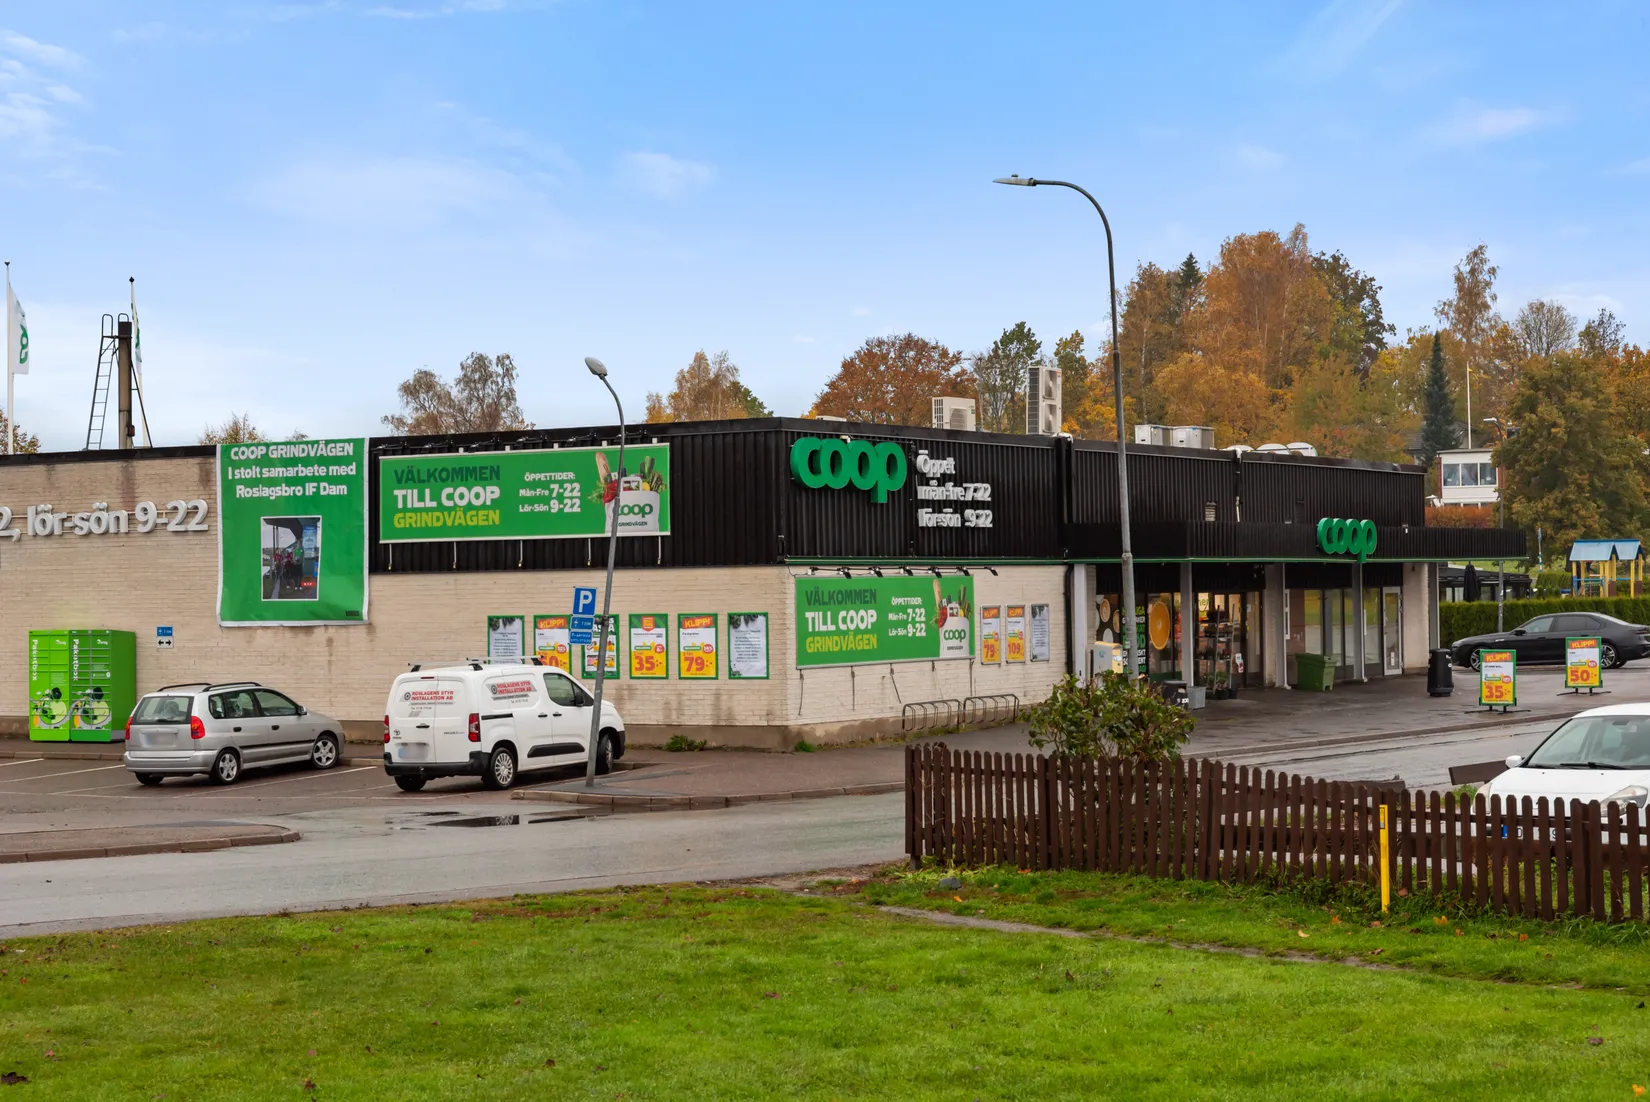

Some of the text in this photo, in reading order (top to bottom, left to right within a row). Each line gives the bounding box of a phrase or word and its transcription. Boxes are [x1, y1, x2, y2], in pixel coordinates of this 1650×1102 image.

[231, 441, 354, 460] COOP GRINDVÄGEN
[228, 462, 356, 479] I stolt samarbete med
[790, 437, 907, 503] coop
[916, 450, 955, 478] Öppet
[393, 465, 500, 484] VÄLKOMMEN
[524, 472, 576, 481] ÖPPETTIDER:
[236, 482, 347, 499] Roslagsbro IF Dam
[393, 485, 501, 508] TILL COOP
[550, 483, 581, 497] 7-22
[519, 499, 581, 513] Lör-Sön 9-22
[27, 502, 129, 536] lör-sön
[135, 499, 209, 533] 9-22
[393, 507, 500, 528] GRINDVÄGEN
[1317, 518, 1377, 563] coop
[578, 591, 593, 613] P
[805, 587, 877, 606] VÄLKOMMEN
[805, 609, 877, 632] TILL COOP
[805, 632, 877, 653] GRINDVÄGEN
[943, 629, 966, 642] coop
